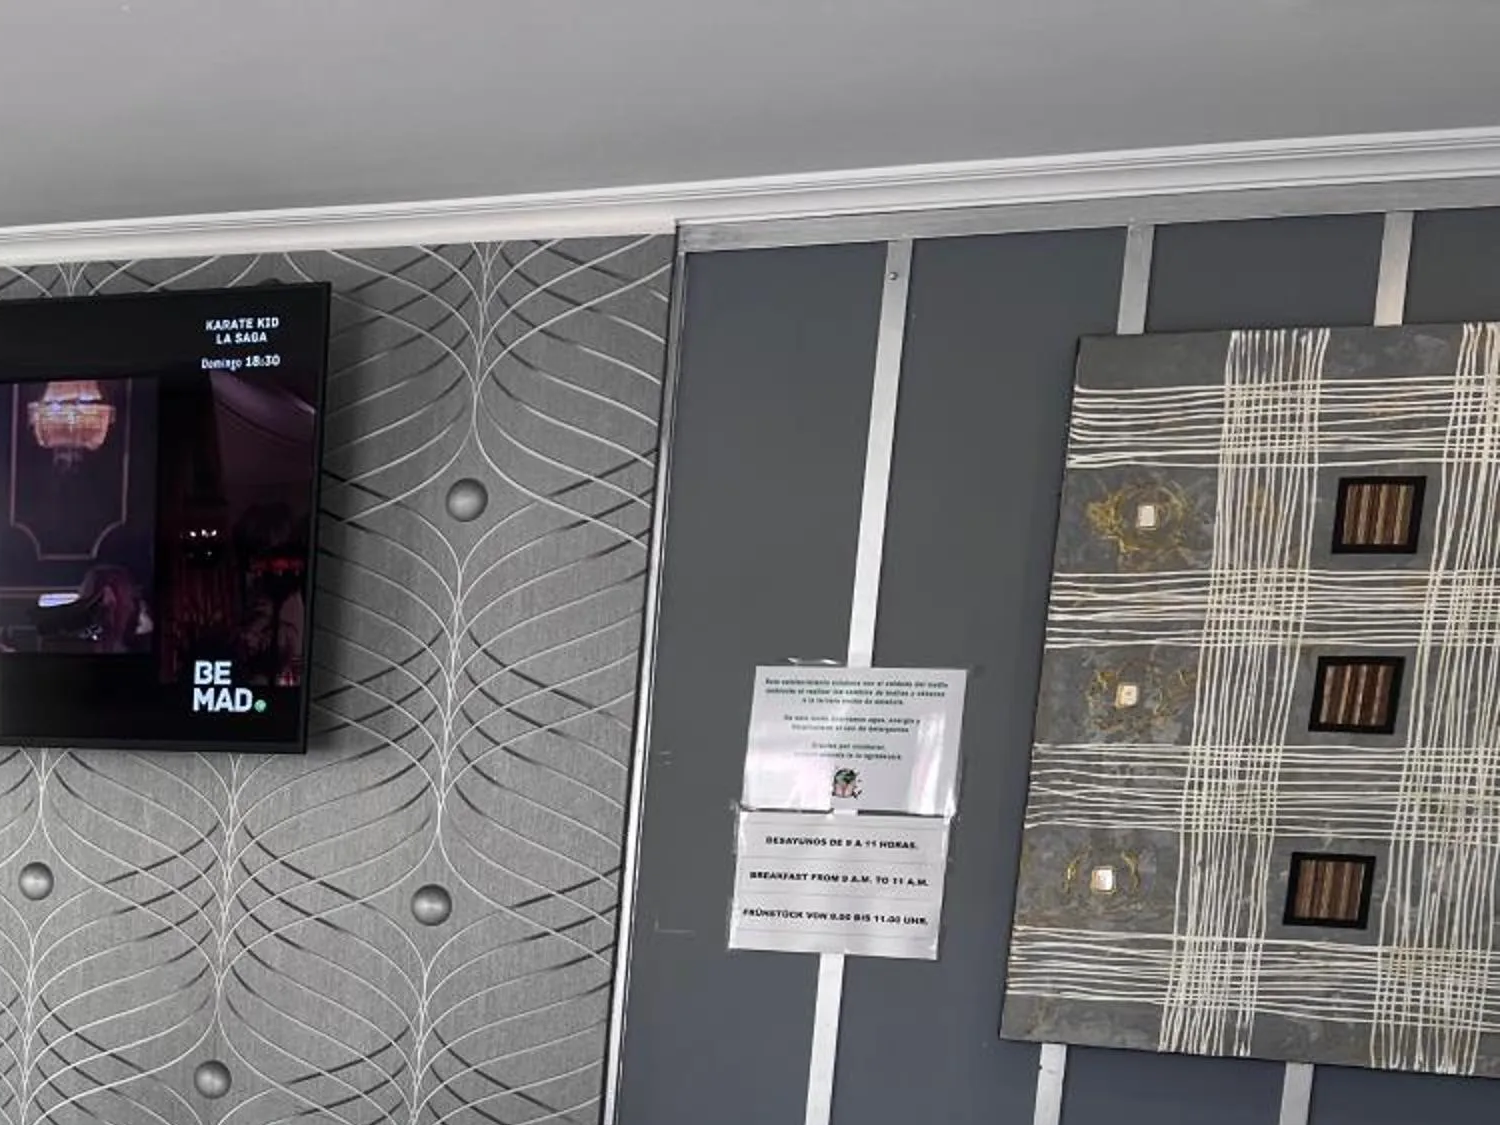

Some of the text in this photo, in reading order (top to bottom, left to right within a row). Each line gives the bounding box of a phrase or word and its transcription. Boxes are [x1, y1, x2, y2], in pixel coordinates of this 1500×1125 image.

[205, 317, 280, 331] KARATE KID
[216, 331, 268, 345] LA SAGA
[201, 354, 281, 371] Domingo 18:30
[194, 660, 232, 685] BE
[765, 836, 827, 846] DESAYUNOS
[829, 838, 842, 847] DE
[749, 871, 807, 880] BREAKFAST
[811, 873, 839, 883] FROM
[876, 875, 889, 885] TO
[853, 912, 871, 922] BIS
